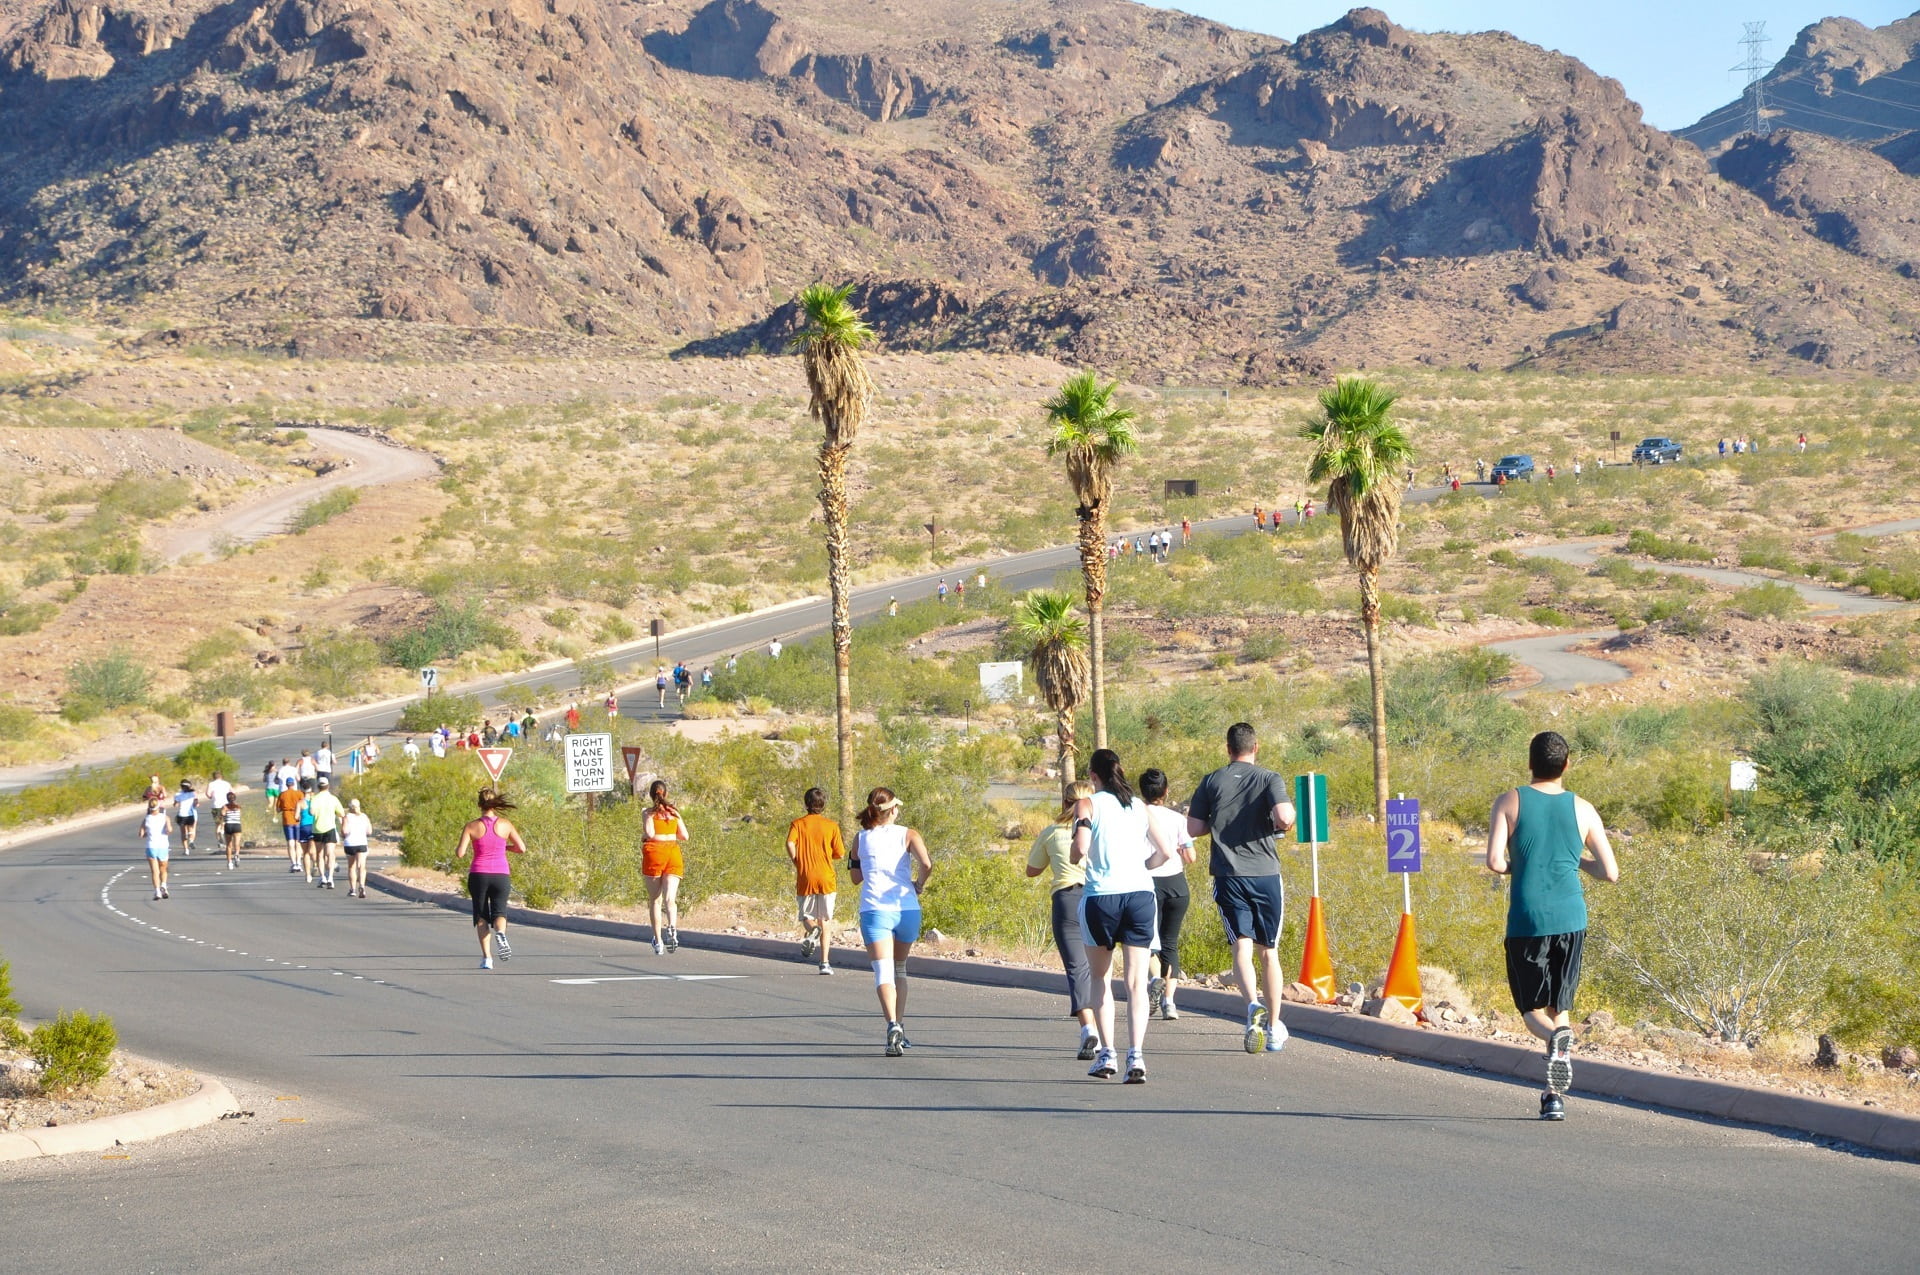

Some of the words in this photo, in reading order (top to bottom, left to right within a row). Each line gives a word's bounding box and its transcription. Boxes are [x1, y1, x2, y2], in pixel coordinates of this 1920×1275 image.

[572, 738, 603, 747] RIGHT
[573, 748, 604, 757] LANE
[574, 758, 603, 767] MUST
[575, 768, 604, 777] TURN
[573, 778, 604, 787] RIGHT
[1387, 813, 1418, 826] MILE
[1389, 828, 1417, 860] 2
